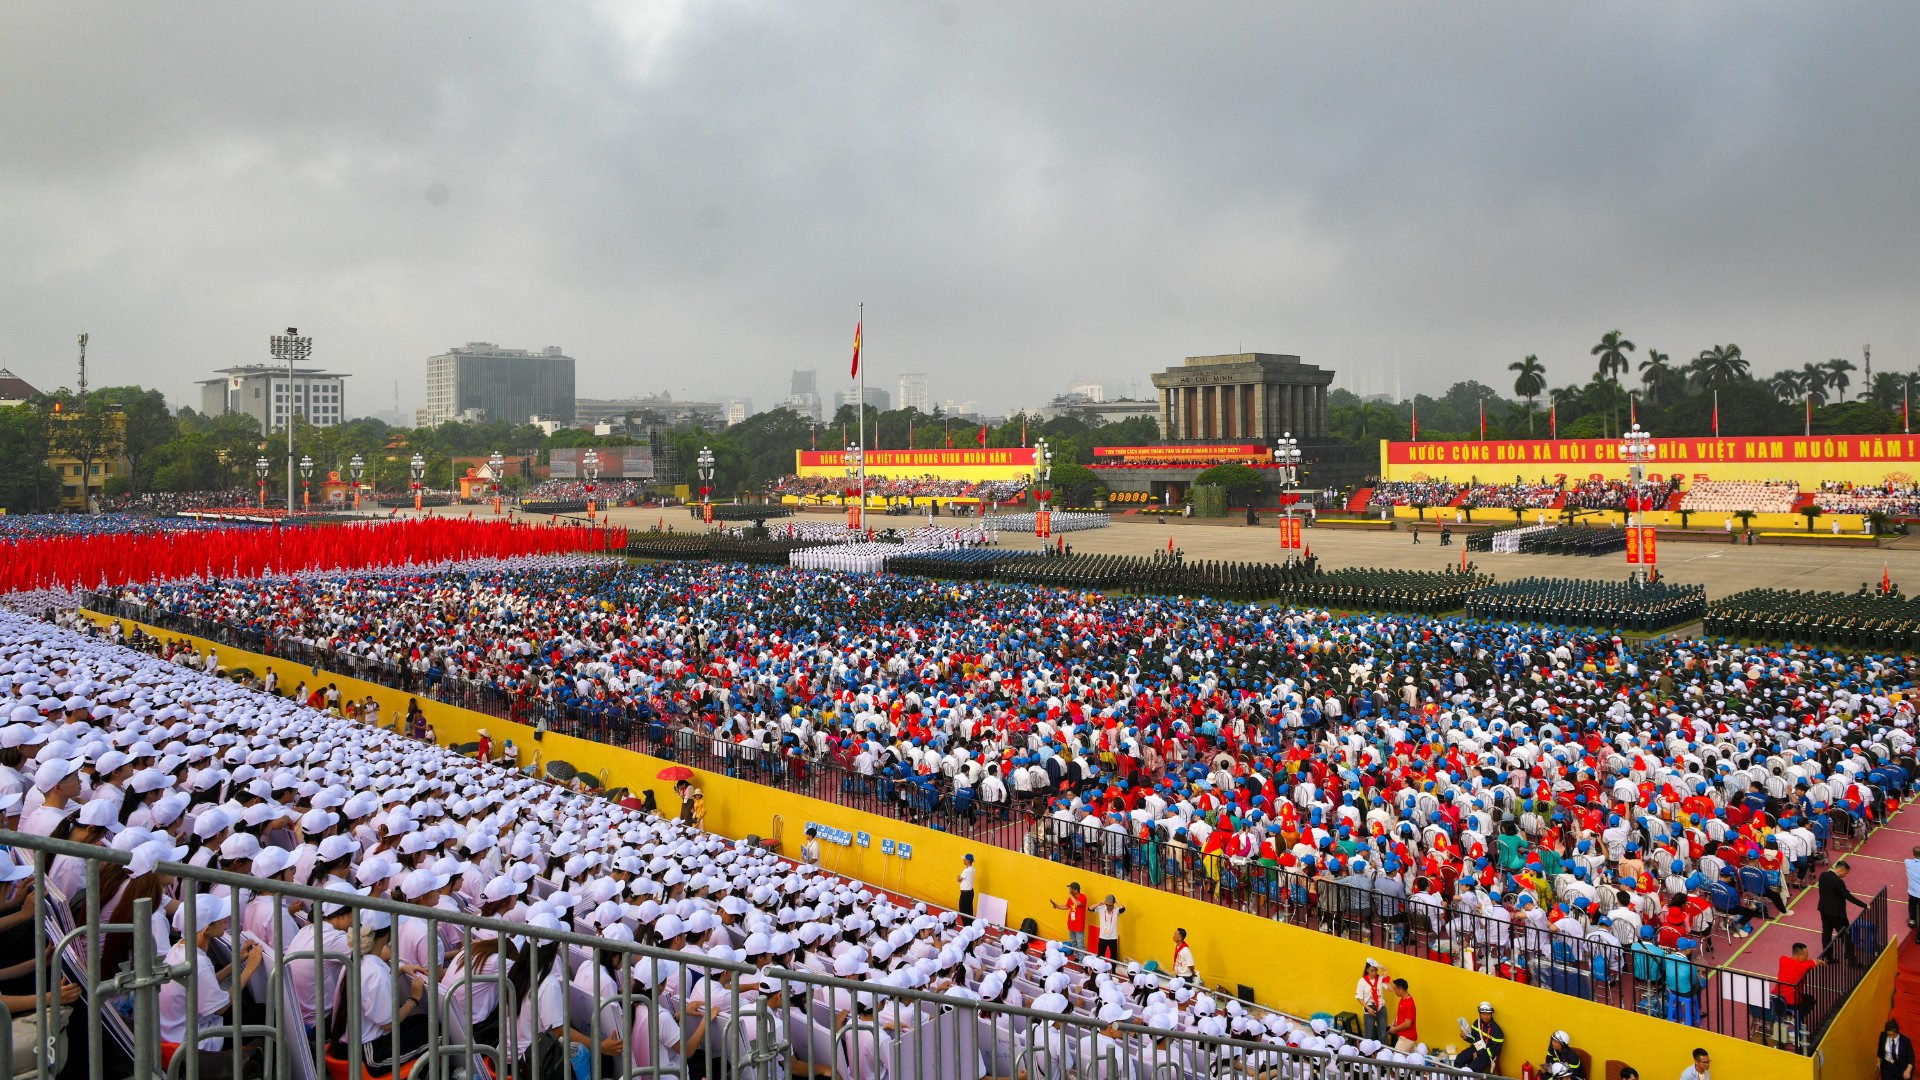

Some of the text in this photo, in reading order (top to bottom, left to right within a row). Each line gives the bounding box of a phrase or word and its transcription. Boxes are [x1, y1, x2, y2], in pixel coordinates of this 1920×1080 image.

[1213, 374, 1233, 382] MINH
[877, 451, 893, 466] VIỆT
[895, 453, 911, 464] NAM
[913, 452, 939, 465] QUANG
[941, 452, 961, 464] VINH
[963, 451, 986, 464] MUÔN
[990, 450, 1007, 464] NĂM
[1409, 443, 1445, 461] NƯỚC
[1452, 443, 1490, 463] CỘNG
[1497, 442, 1526, 461] HÒA
[1533, 442, 1552, 460] XÃ
[1559, 442, 1586, 462] HỘI
[1696, 439, 1736, 462] VIỆT
[1745, 441, 1783, 459] NAM
[1794, 438, 1848, 458] MUÔN
[1859, 438, 1902, 458] NĂM
